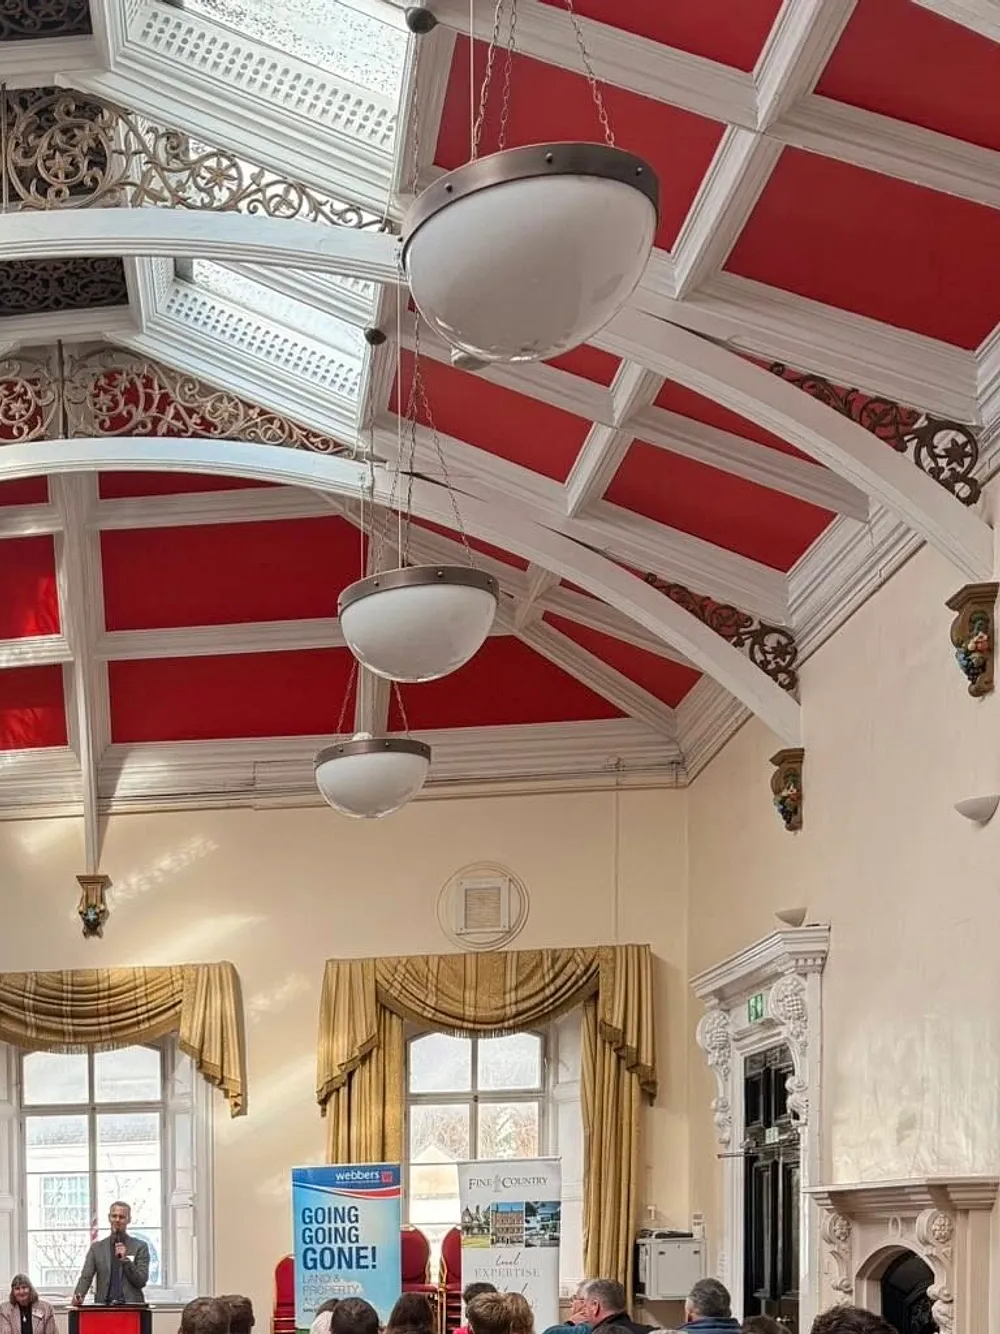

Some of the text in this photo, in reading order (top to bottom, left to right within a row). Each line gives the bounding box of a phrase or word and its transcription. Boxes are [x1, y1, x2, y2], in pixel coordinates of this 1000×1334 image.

[335, 1171, 380, 1180] webbers
[502, 1176, 548, 1189] COUNTRY
[302, 1206, 359, 1224] GOING
[302, 1226, 359, 1244] GOING
[302, 1246, 376, 1270] GONE!
[474, 1268, 540, 1277] EXPERTISE
[303, 1274, 330, 1284] LAND
[303, 1284, 360, 1296] PROPERTY
